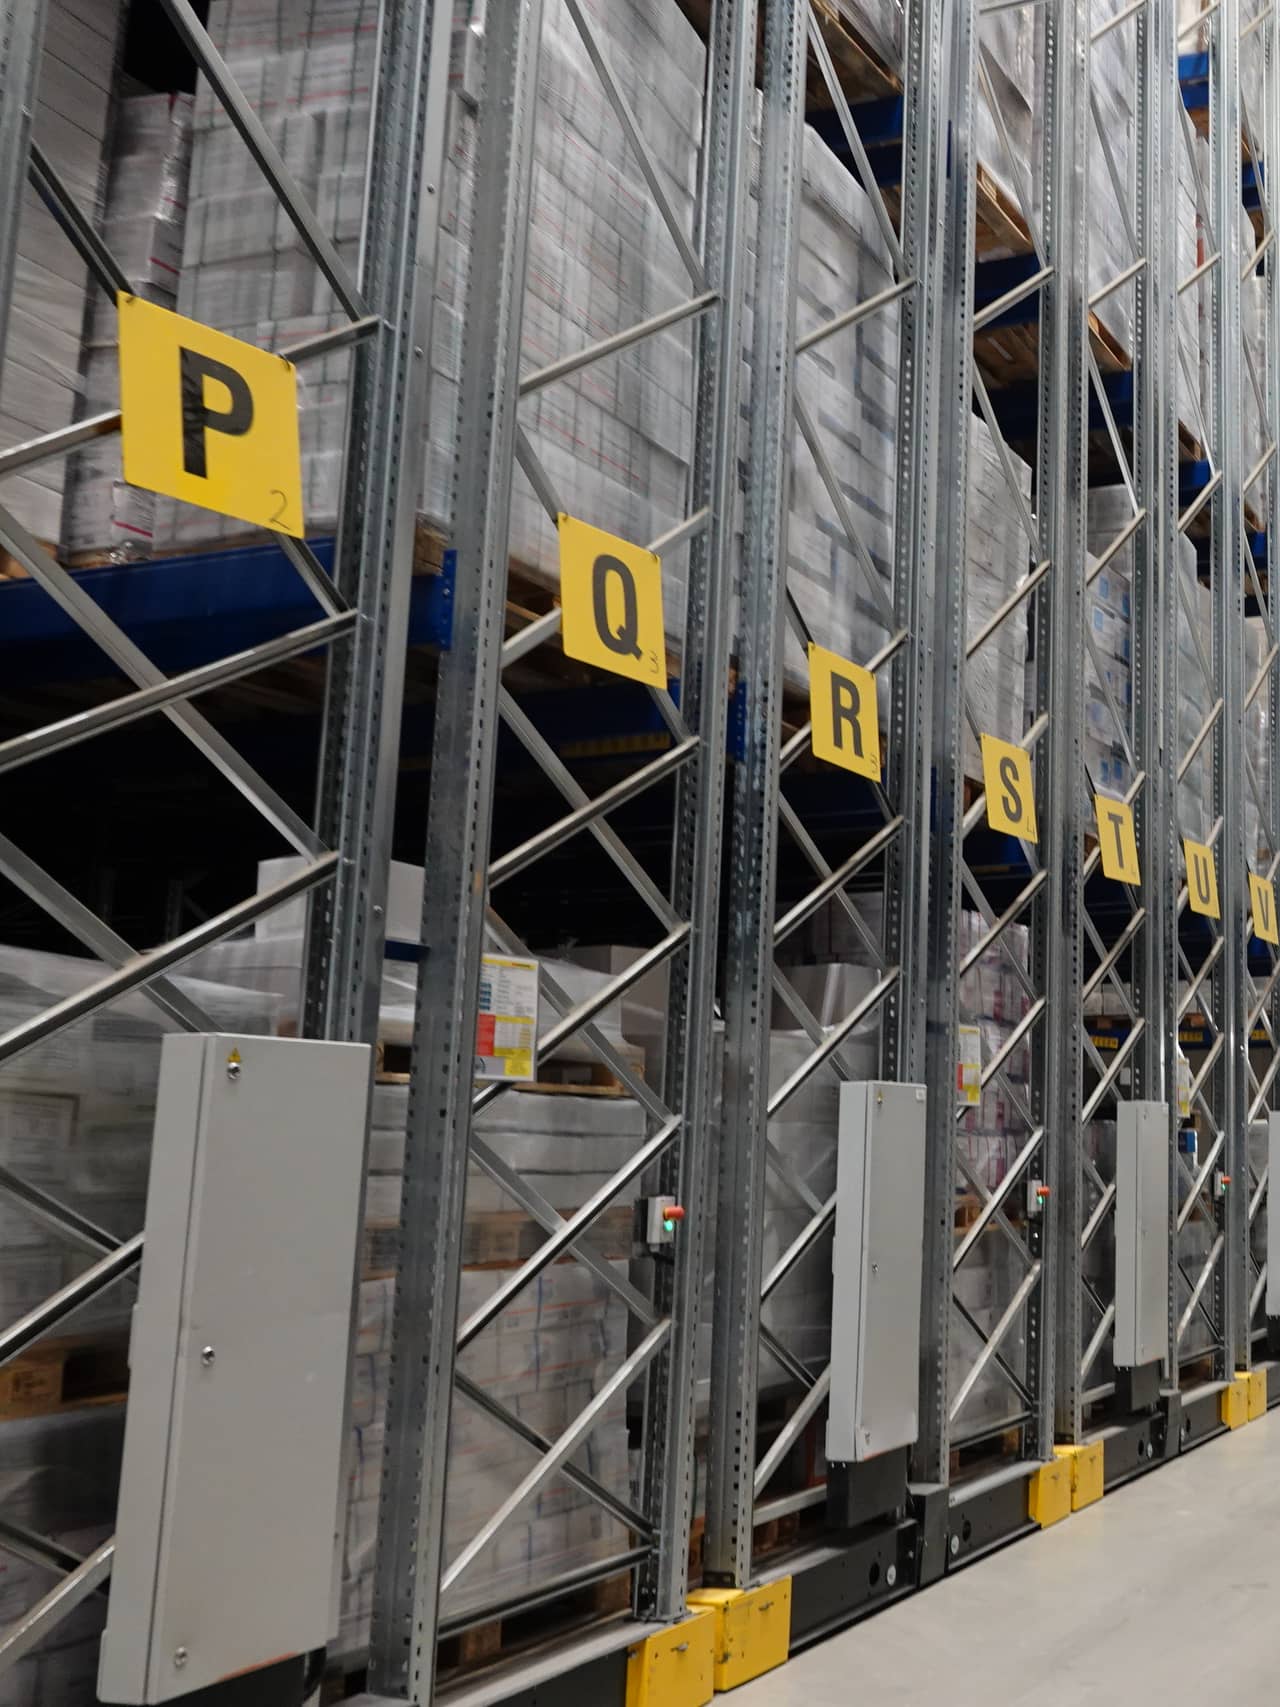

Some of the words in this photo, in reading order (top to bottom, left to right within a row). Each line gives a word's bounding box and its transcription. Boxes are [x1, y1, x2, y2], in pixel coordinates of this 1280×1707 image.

[179, 345, 254, 479] P
[270, 489, 291, 530] 2
[592, 554, 642, 660] Q
[830, 670, 864, 758] R
[1000, 756, 1022, 824] S
[1107, 811, 1124, 869] T
[1193, 853, 1210, 905] U
[1257, 886, 1269, 932] V
